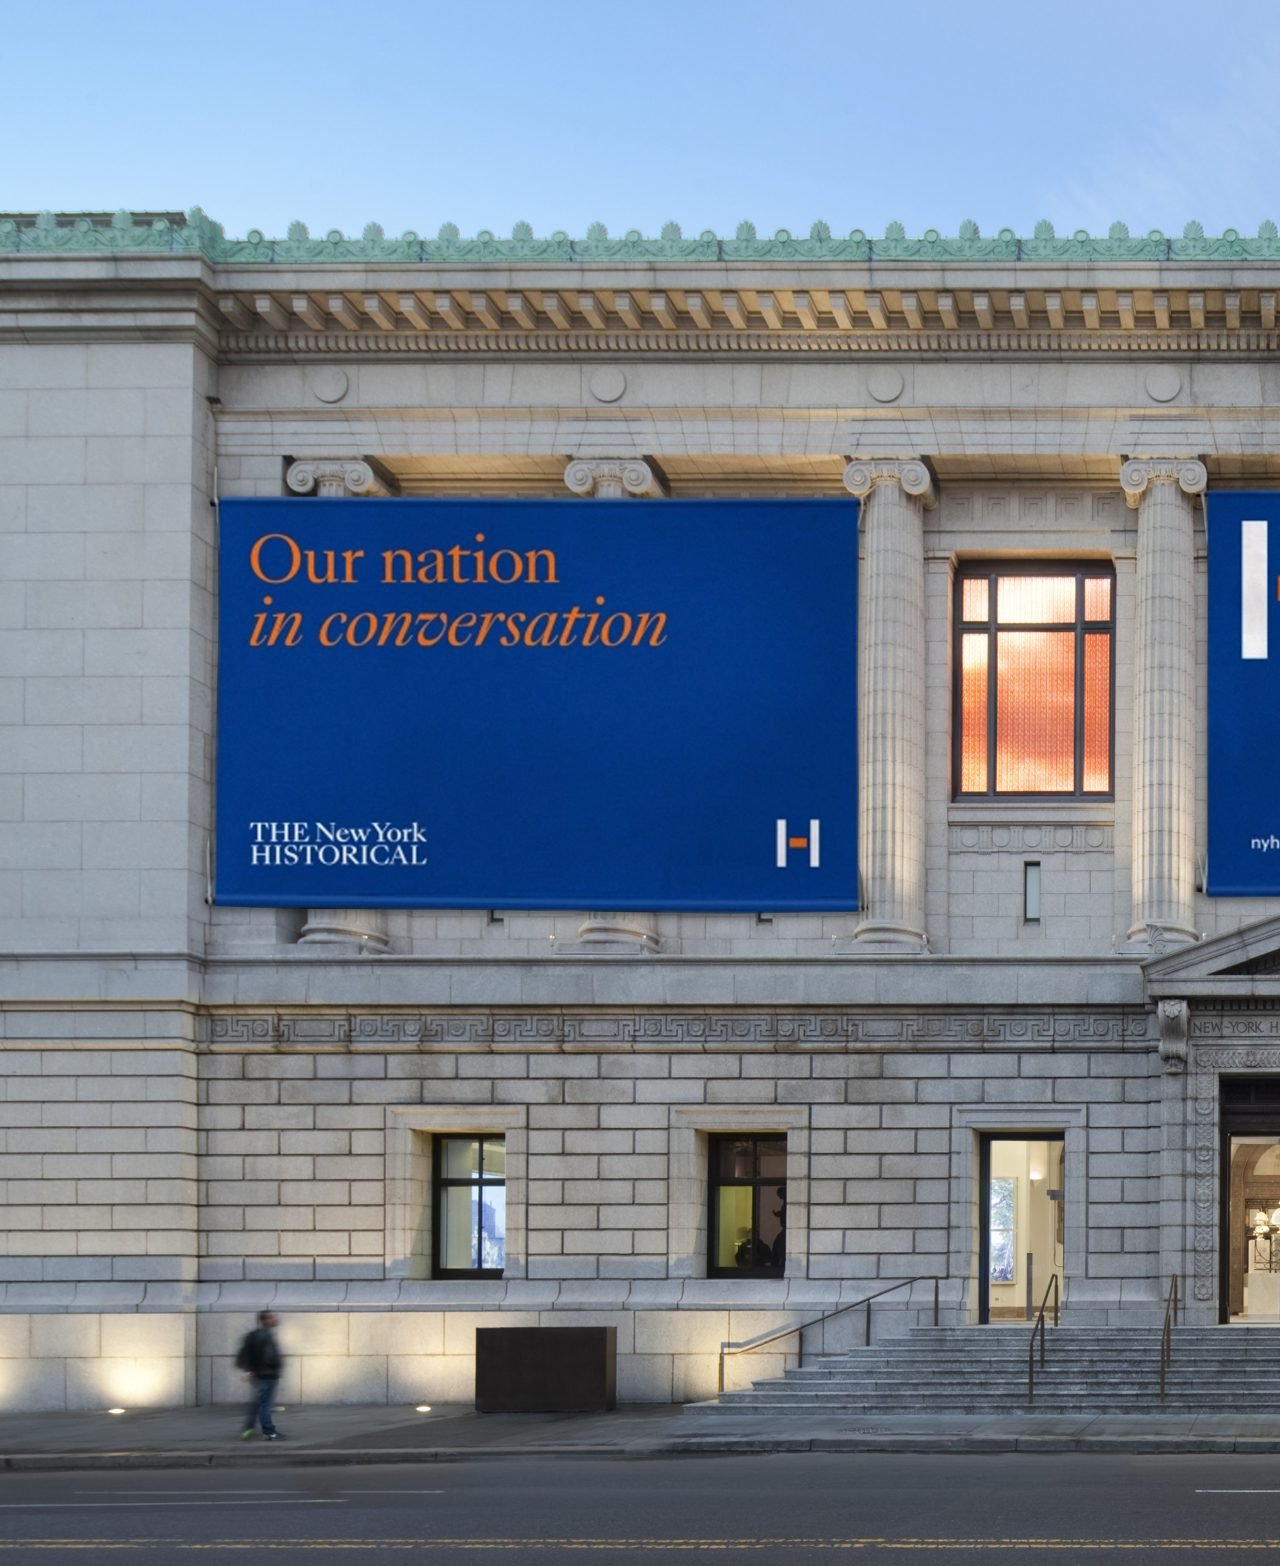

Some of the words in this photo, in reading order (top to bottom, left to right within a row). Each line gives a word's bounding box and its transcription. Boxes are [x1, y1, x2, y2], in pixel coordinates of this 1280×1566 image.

[250, 533, 364, 584] Our
[382, 532, 559, 584] nation
[249, 595, 303, 647] in
[319, 595, 667, 647] conversation
[249, 822, 310, 843] THE
[251, 844, 428, 865] HISTORICAL
